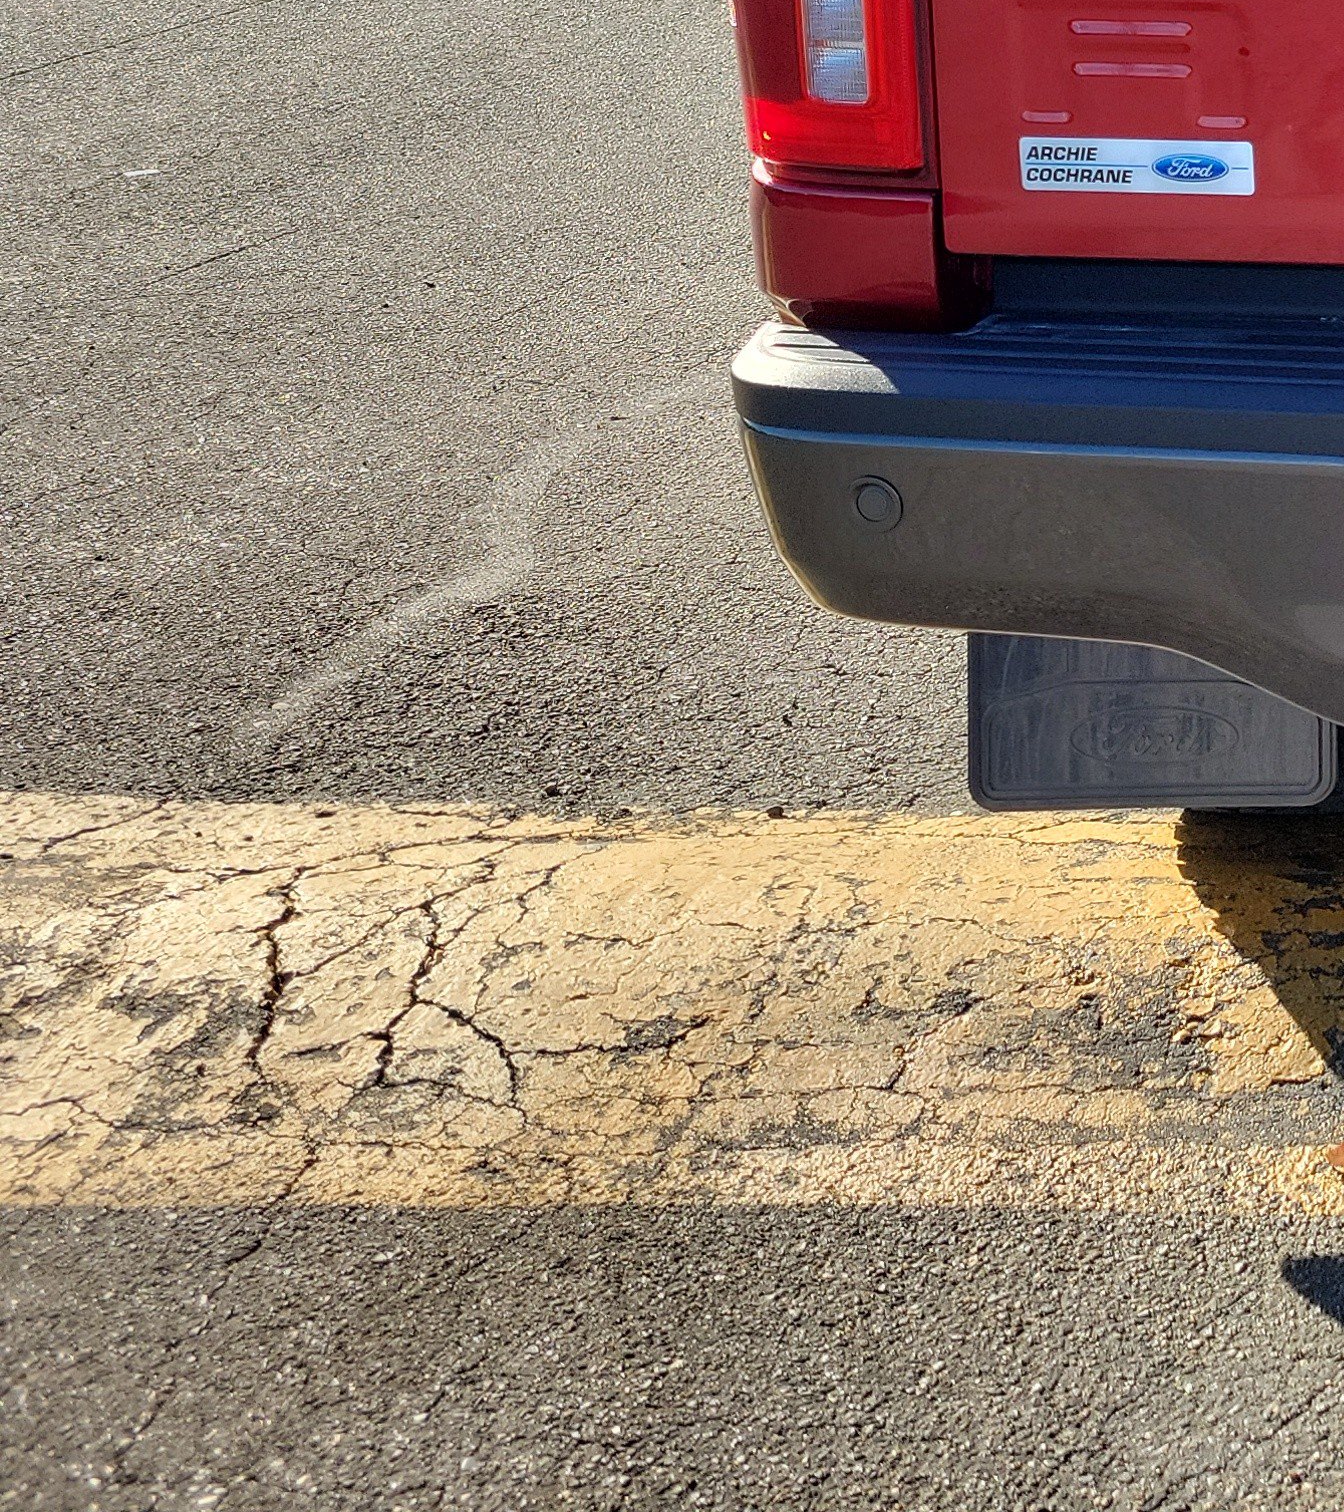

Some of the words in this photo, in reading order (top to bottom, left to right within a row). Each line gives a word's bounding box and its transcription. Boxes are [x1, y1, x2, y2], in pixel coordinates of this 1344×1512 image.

[1025, 145, 1099, 162] ARCHIE
[1026, 166, 1134, 185] COCHRANE
[1167, 156, 1214, 179] Ford
